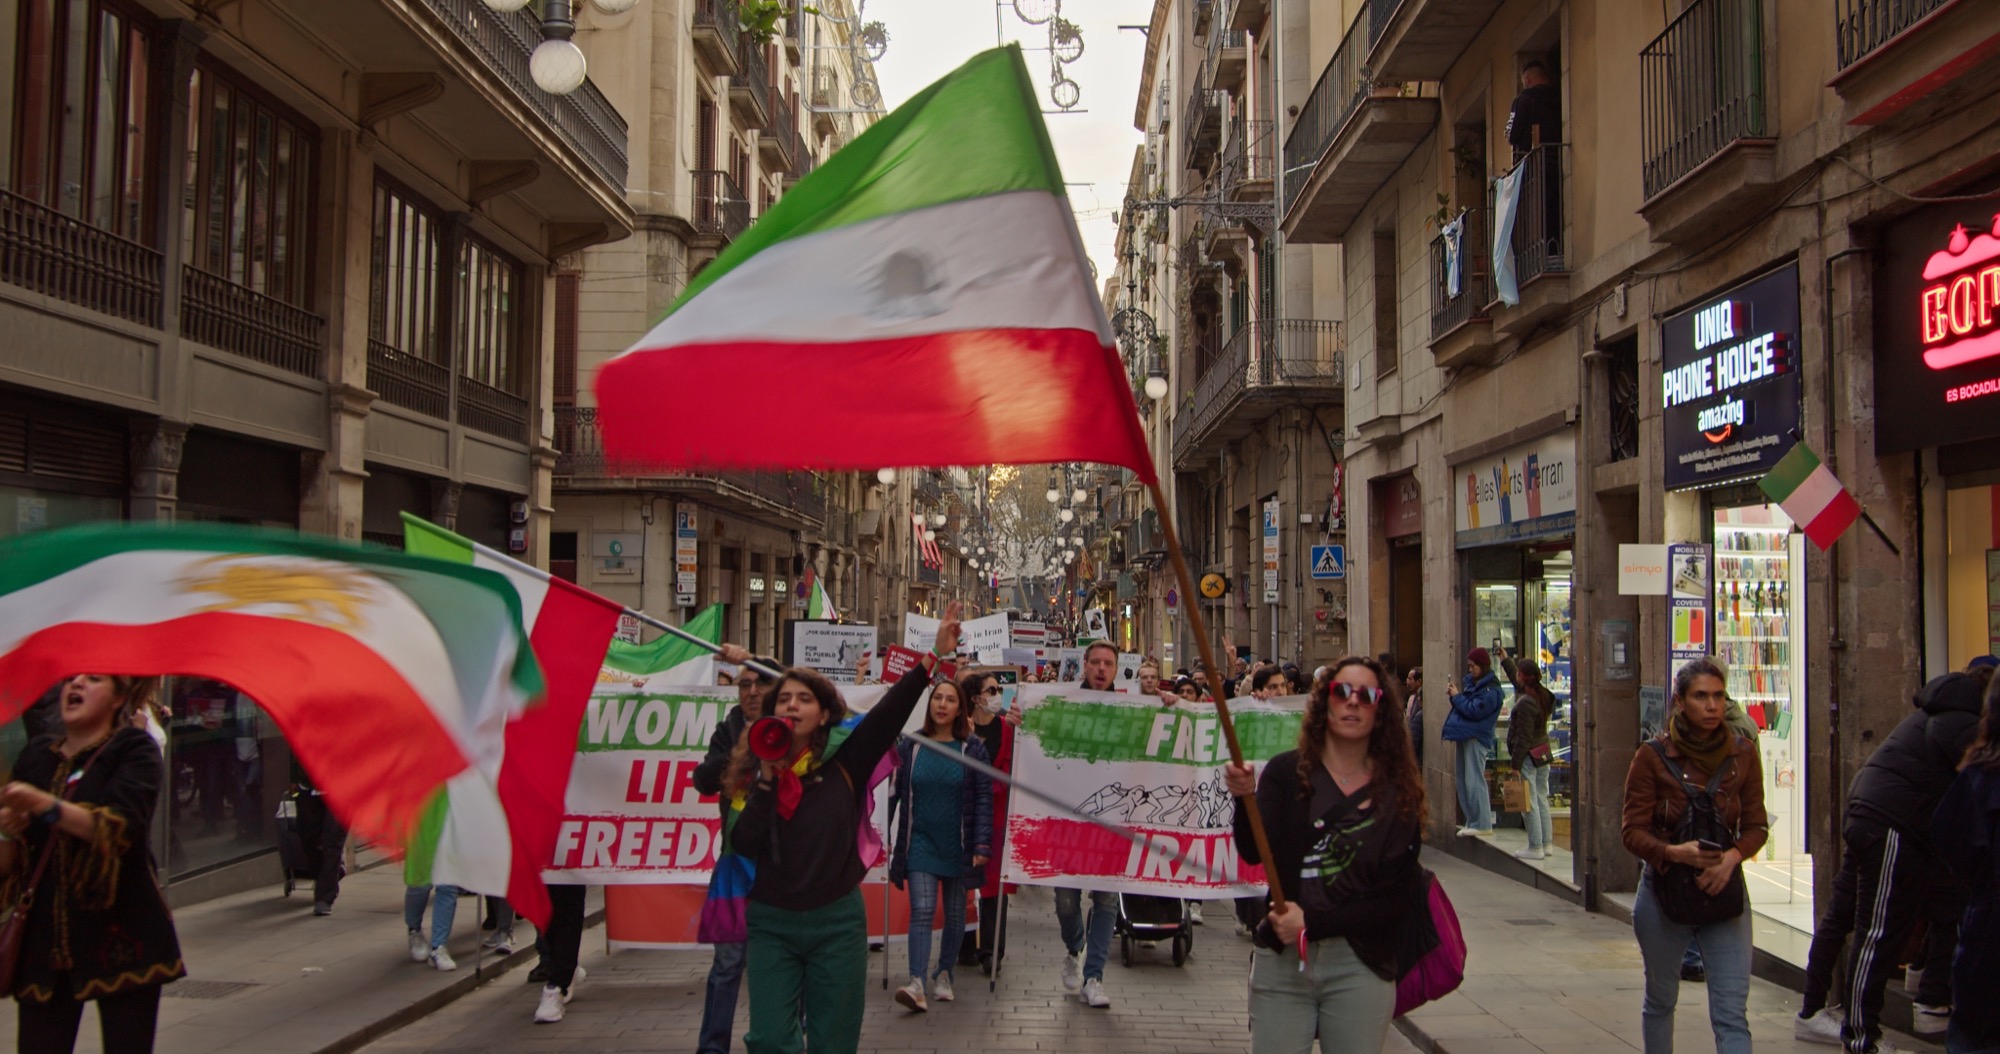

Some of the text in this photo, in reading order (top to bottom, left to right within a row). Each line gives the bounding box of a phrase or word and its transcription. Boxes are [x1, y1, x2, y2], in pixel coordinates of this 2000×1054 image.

[1694, 299, 1734, 350] UNIQ
[1662, 332, 1775, 409] PHONE HOUSE
[1946, 388, 1958, 403] ES
[1697, 394, 1744, 433] amazing
[1466, 452, 1564, 505] Belles Arts Ferran
[1674, 546, 1705, 554] MOBILES
[1624, 562, 1663, 576] simyo
[1675, 599, 1704, 607] COVERS
[984, 626, 1003, 637] Iran
[973, 641, 1001, 653] People
[1684, 651, 1705, 660] CARDS
[586, 699, 737, 747] WOM
[1124, 832, 1238, 884] IRAN
